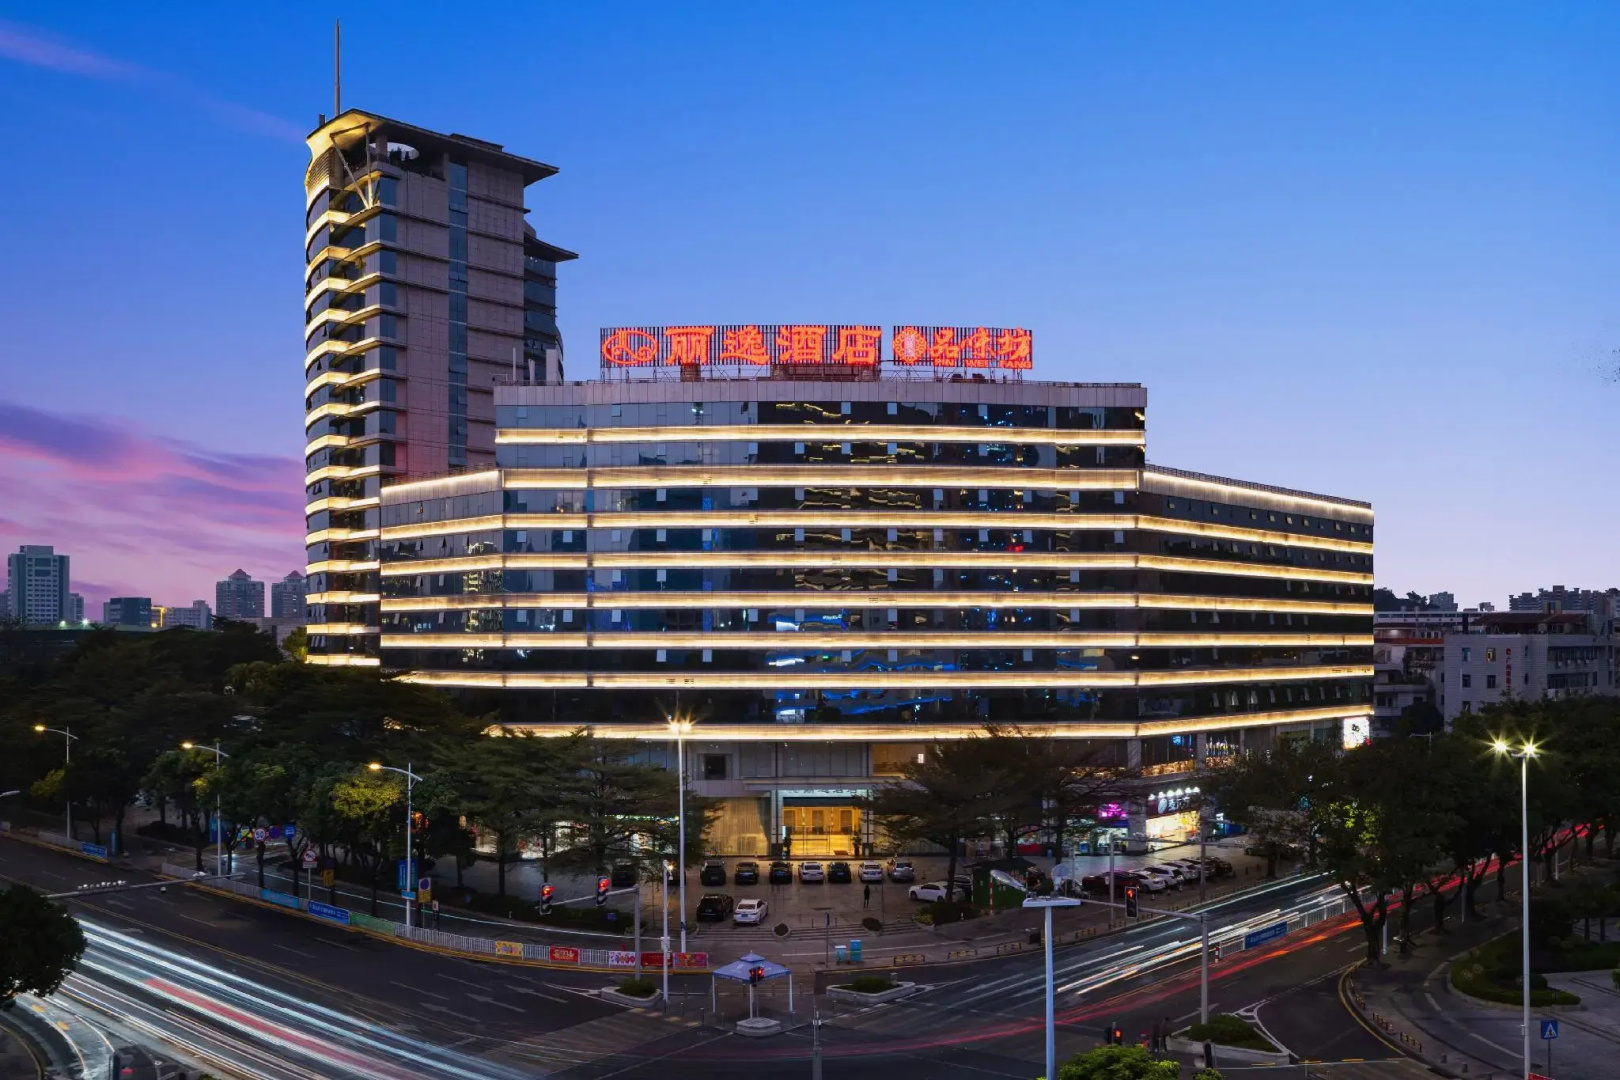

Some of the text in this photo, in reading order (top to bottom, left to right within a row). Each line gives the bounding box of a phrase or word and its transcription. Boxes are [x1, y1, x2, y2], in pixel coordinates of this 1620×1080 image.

[665, 325, 882, 366] 丽逸酒店
[929, 326, 1032, 360] 品味坊
[964, 359, 988, 368] WEI
[999, 360, 1032, 369] FANG
